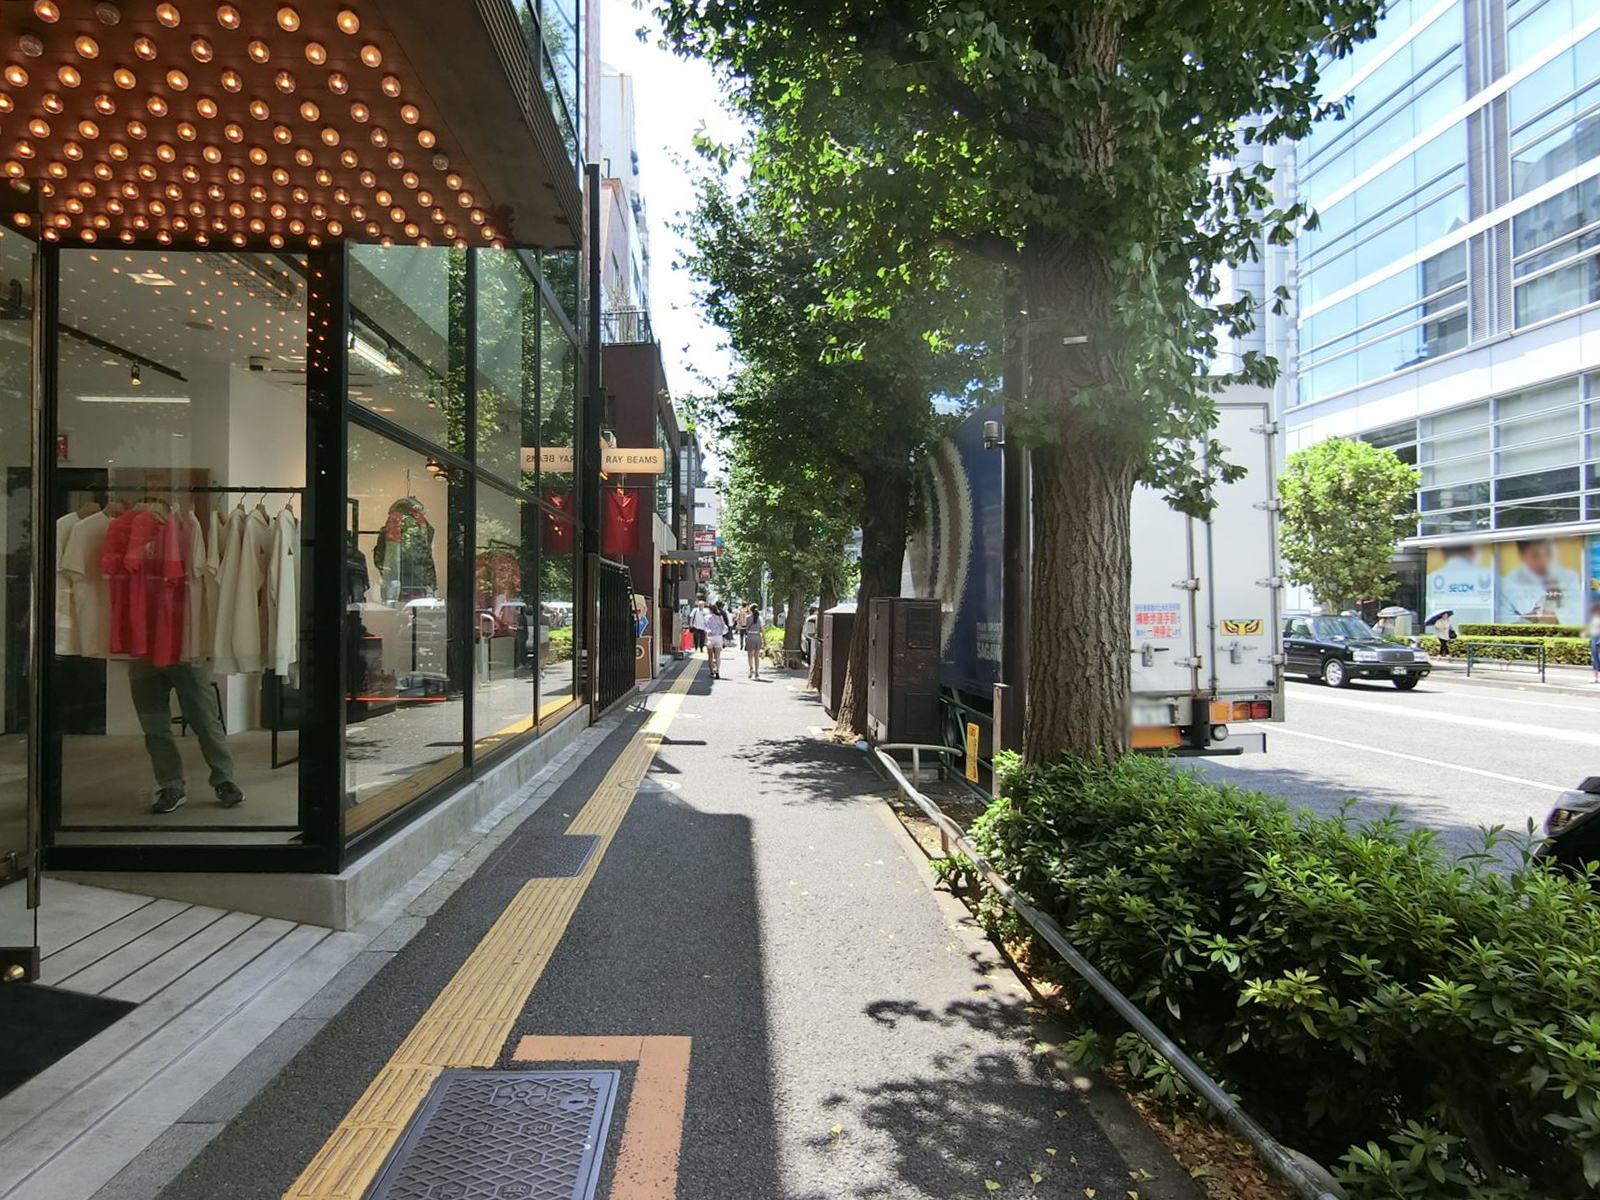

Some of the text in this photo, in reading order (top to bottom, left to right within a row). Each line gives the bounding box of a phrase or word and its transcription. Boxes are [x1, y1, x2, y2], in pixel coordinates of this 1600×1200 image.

[605, 455, 658, 464] RAY BEAMS
[1449, 584, 1474, 593] SECOM
